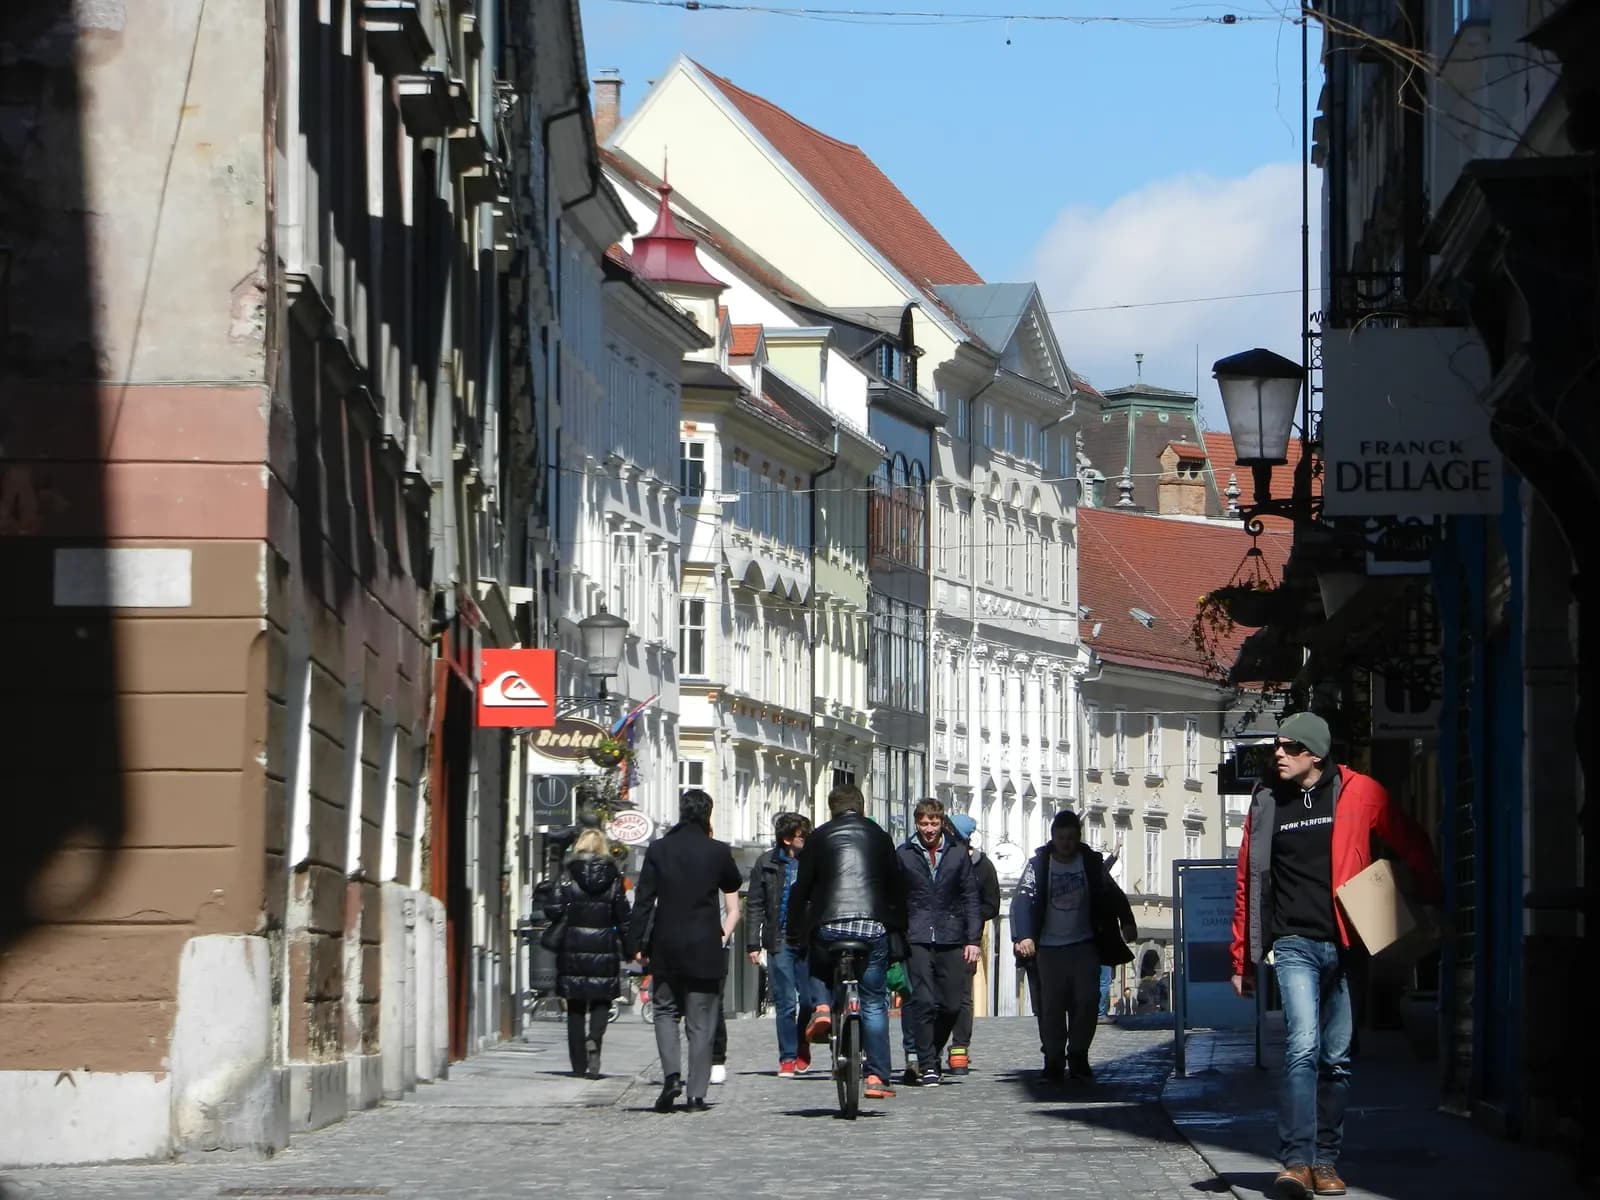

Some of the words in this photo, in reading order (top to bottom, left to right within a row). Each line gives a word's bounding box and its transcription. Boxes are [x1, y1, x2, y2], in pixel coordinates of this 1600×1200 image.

[1360, 439, 1464, 456] FRANCK
[1335, 459, 1491, 492] DELLAGE
[1280, 821, 1299, 832] PEAK
